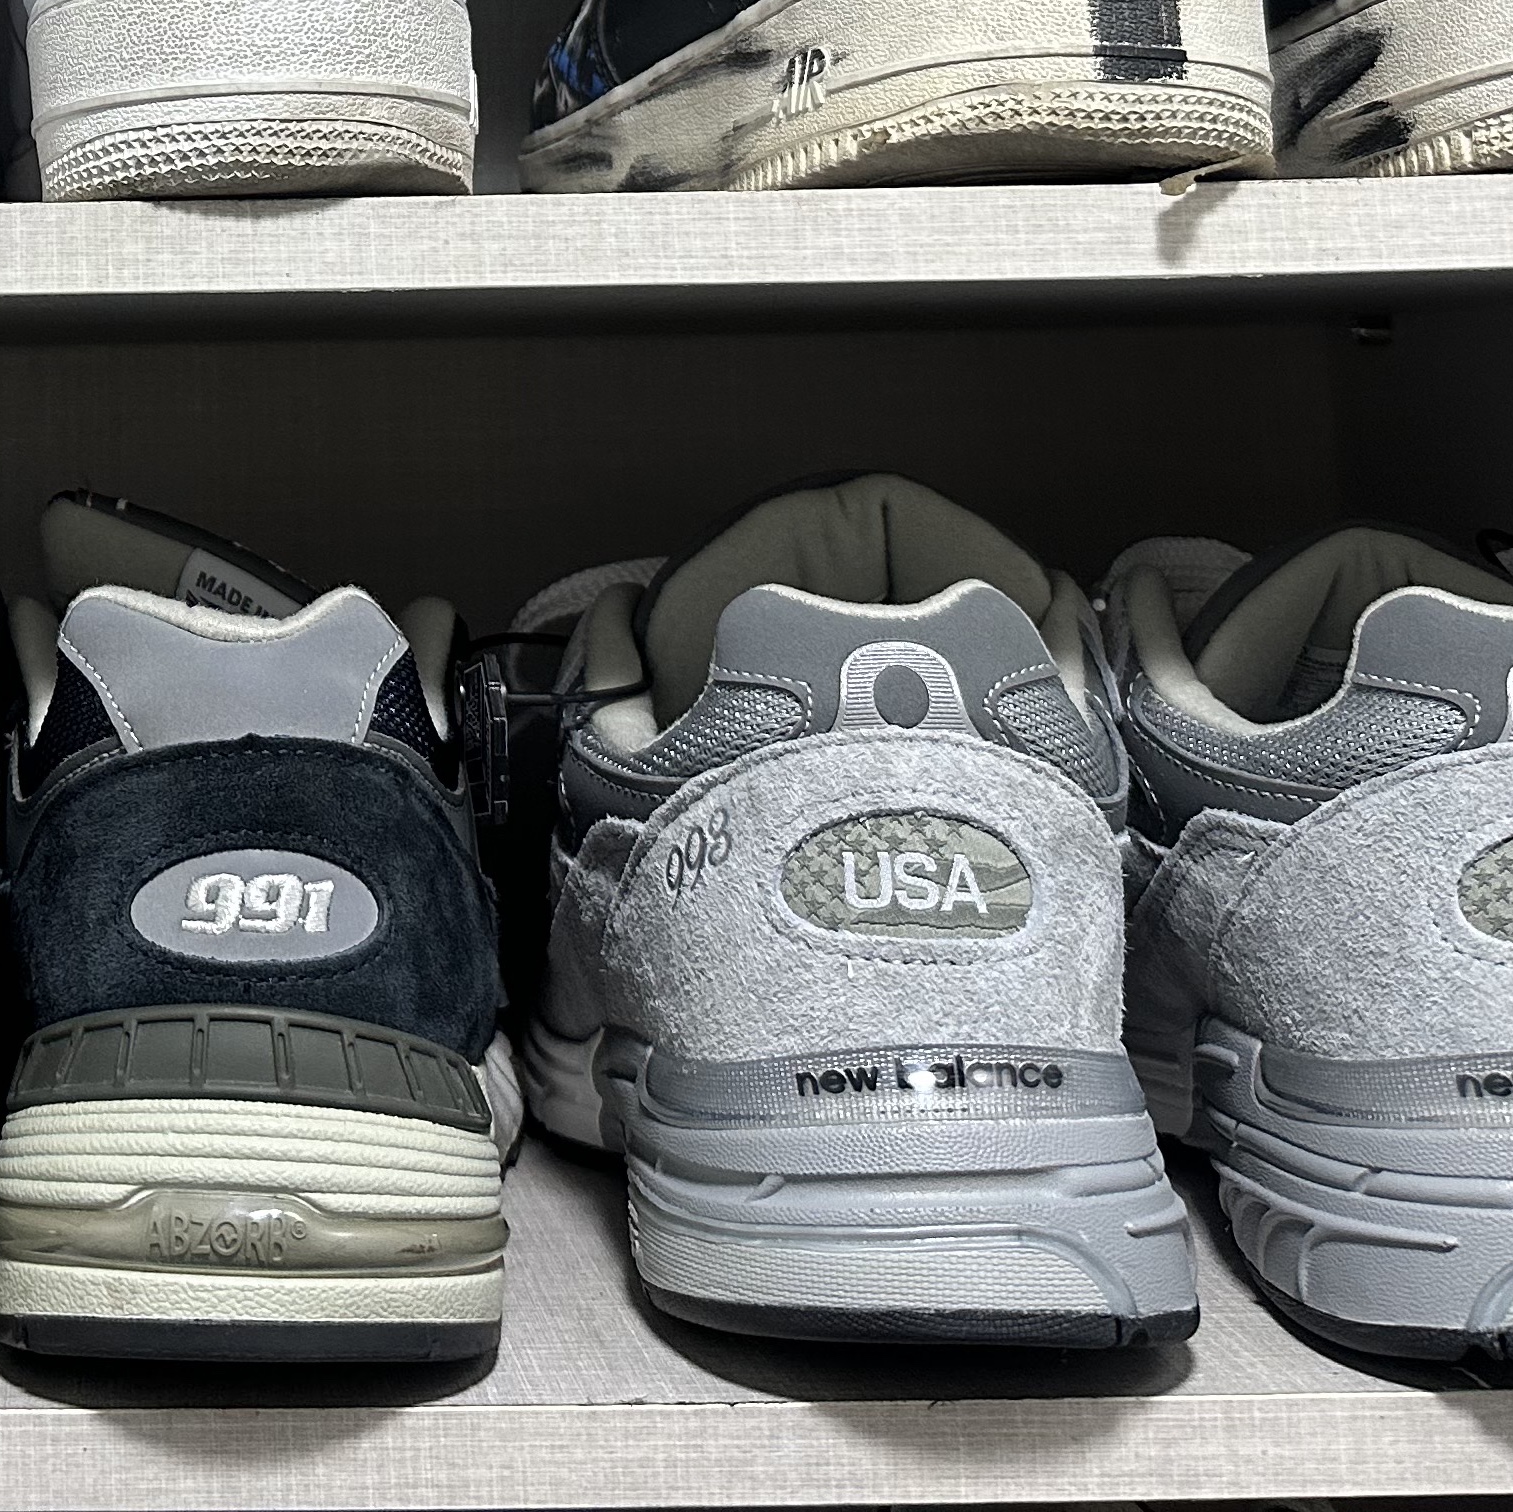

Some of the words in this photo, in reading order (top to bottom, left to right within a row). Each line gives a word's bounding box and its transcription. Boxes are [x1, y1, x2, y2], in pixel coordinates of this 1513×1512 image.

[771, 46, 830, 120] AIR
[195, 570, 254, 614] MADE
[181, 871, 335, 936] 991
[841, 849, 989, 914] USA
[795, 1066, 880, 1097] new
[893, 1054, 1064, 1090] balance
[1455, 1072, 1513, 1098] ne
